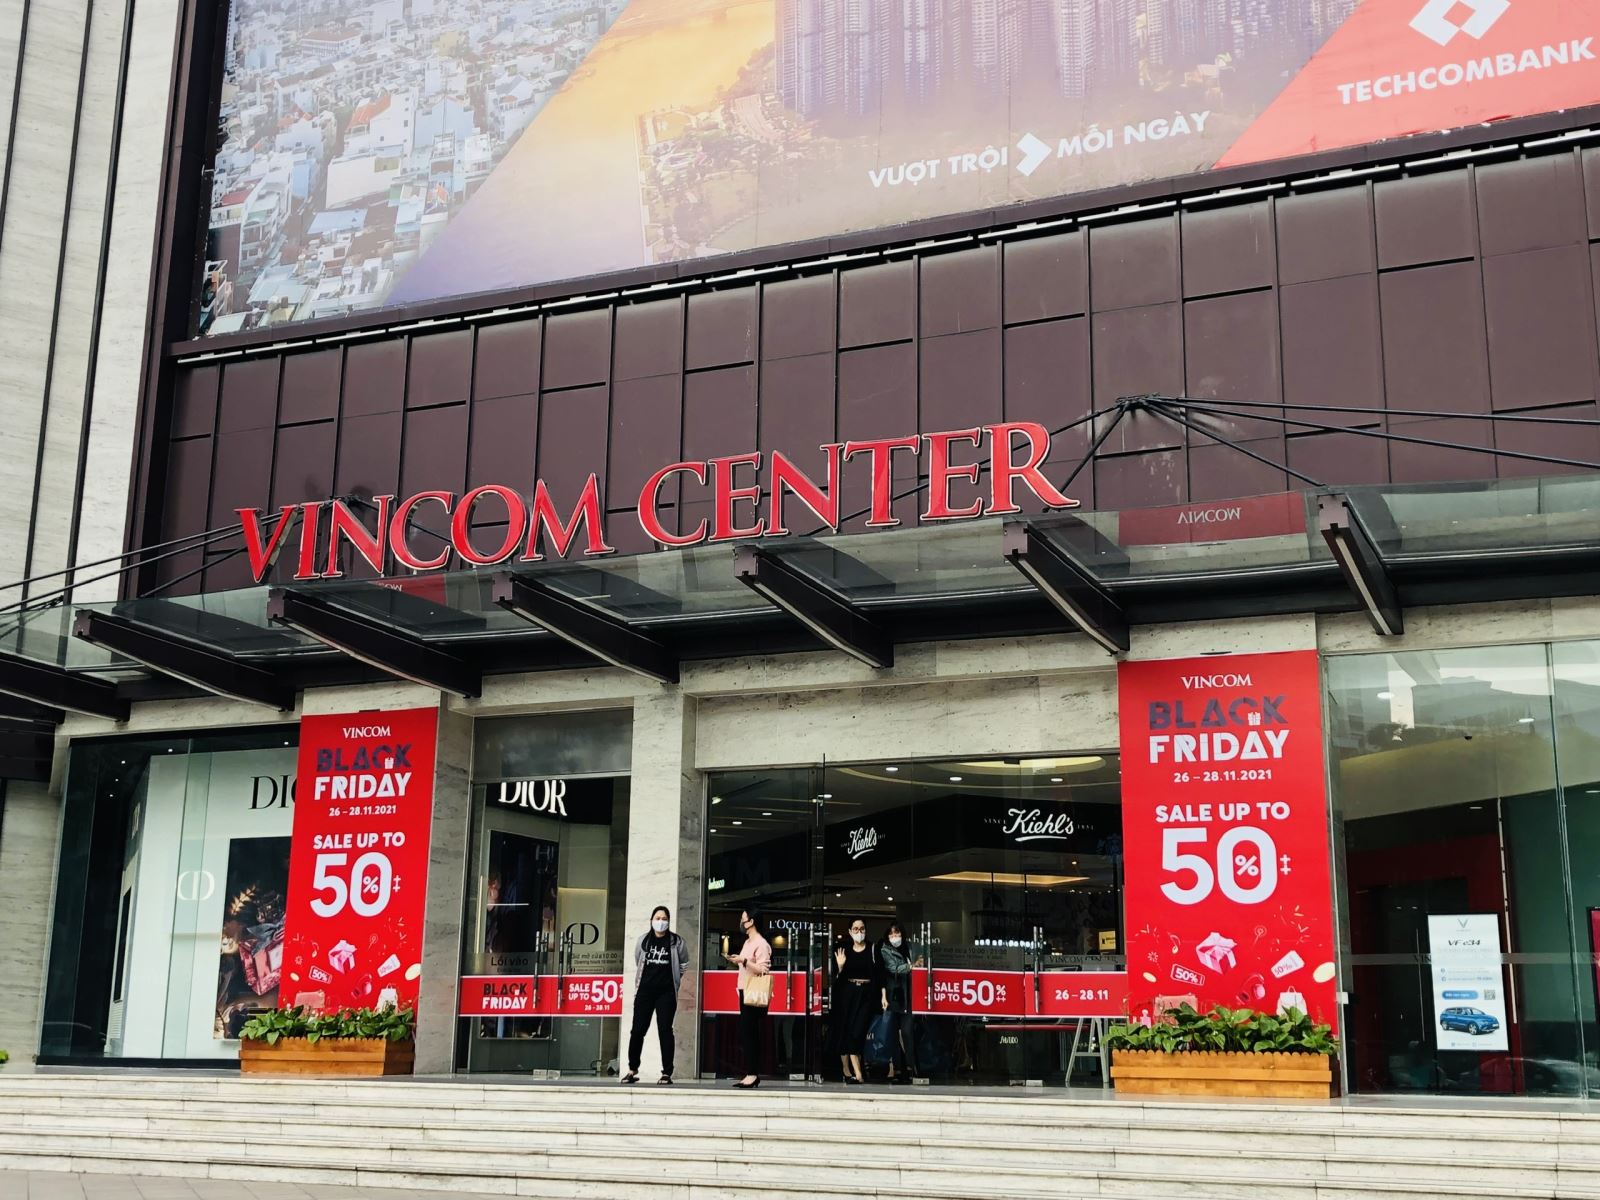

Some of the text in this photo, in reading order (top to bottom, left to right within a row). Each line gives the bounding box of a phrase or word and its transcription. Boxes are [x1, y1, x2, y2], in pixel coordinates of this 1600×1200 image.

[1337, 37, 1596, 104] TECHCOMBANK
[868, 110, 1210, 188] VƯỢT TRỘI MỖI NGÀY
[233, 421, 1080, 583] VINCOM CENTER
[1181, 673, 1253, 689] VINCOM
[1149, 695, 1288, 730] BLACK
[342, 726, 391, 738] VINCOM
[1149, 730, 1290, 764] FRIDAY
[316, 743, 412, 772] BLACK
[1174, 773, 1189, 783] 26
[1203, 769, 1272, 782] 28.11.2021
[248, 775, 297, 810] DI
[314, 772, 412, 800] FRIDAY
[498, 780, 567, 816] DIOR
[329, 807, 341, 817] 26
[349, 805, 396, 816] 28.11.2021
[1155, 801, 1290, 823] SALE UP TO
[1003, 808, 1074, 834] Kiehl's
[313, 832, 405, 850] SALE UP TO
[847, 827, 877, 854] Kiehl's
[1175, 967, 1199, 984] 50%
[483, 982, 527, 996] BLACK
[569, 983, 590, 993] SALE
[934, 982, 960, 993] SALE
[1055, 990, 1069, 1000] 26
[1079, 990, 1108, 1000] 28.11
[482, 996, 528, 1009] FRIDAY
[568, 993, 590, 1001] UP TO
[934, 993, 960, 1002] UP TO
